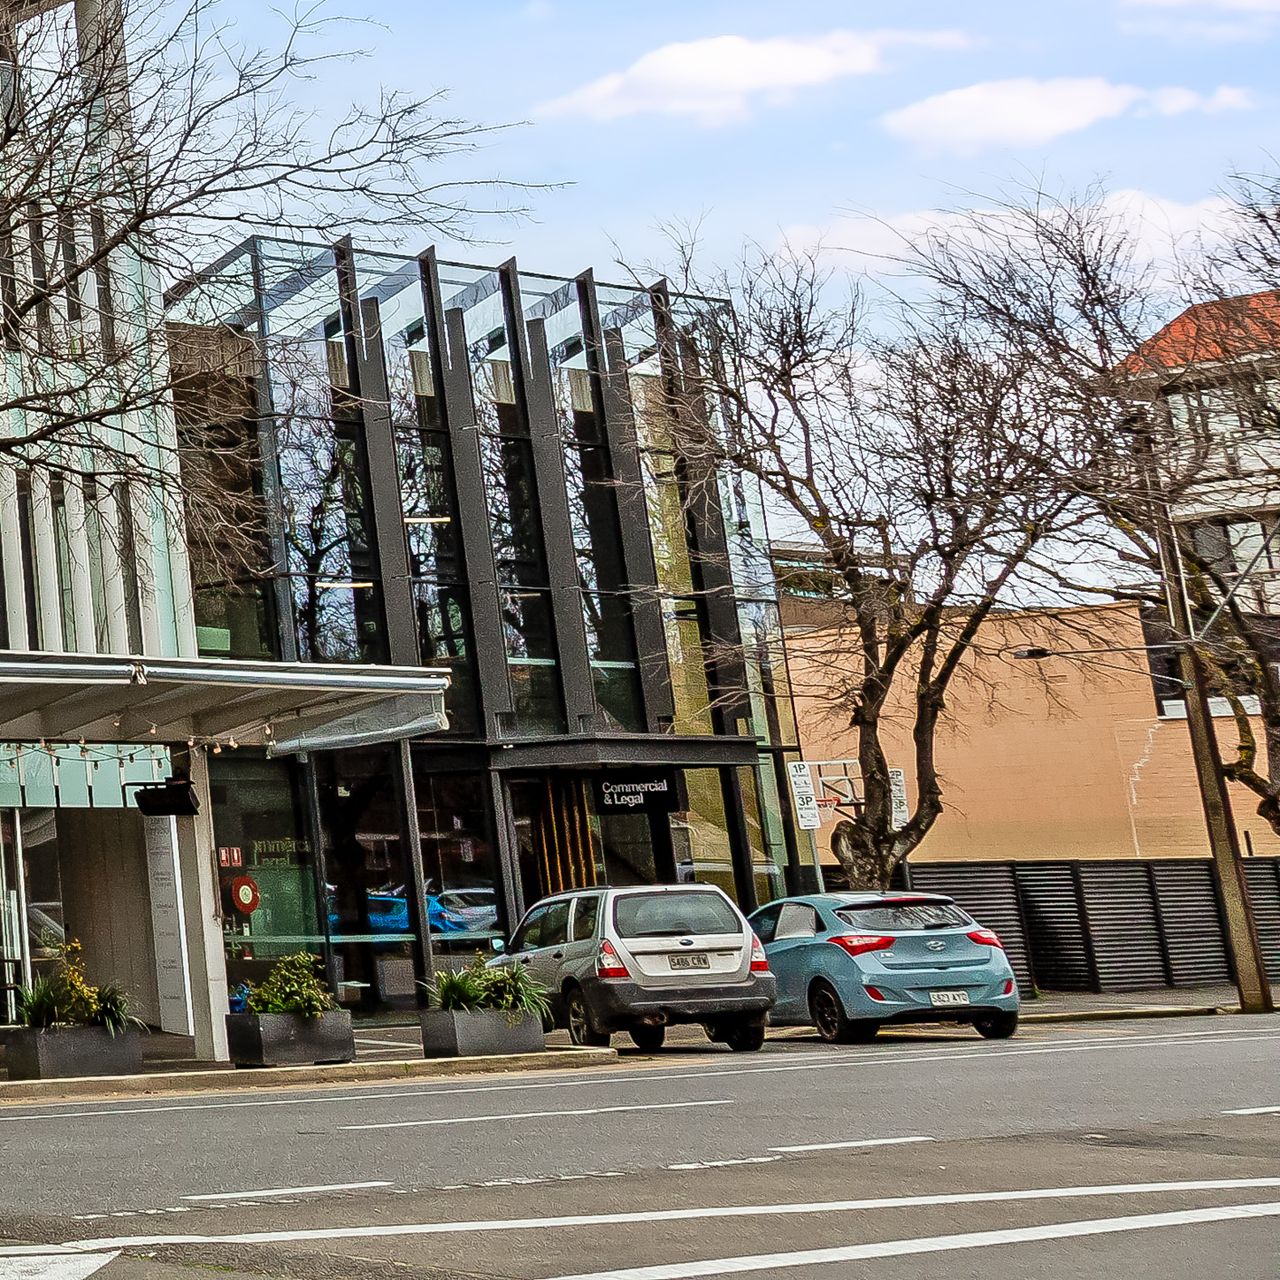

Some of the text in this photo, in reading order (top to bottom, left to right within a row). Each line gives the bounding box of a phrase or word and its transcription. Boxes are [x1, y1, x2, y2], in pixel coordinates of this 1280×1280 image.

[793, 764, 806, 773] 1P
[602, 779, 668, 793] Commercial
[604, 792, 644, 807] & Legal
[798, 796, 813, 806] 3P
